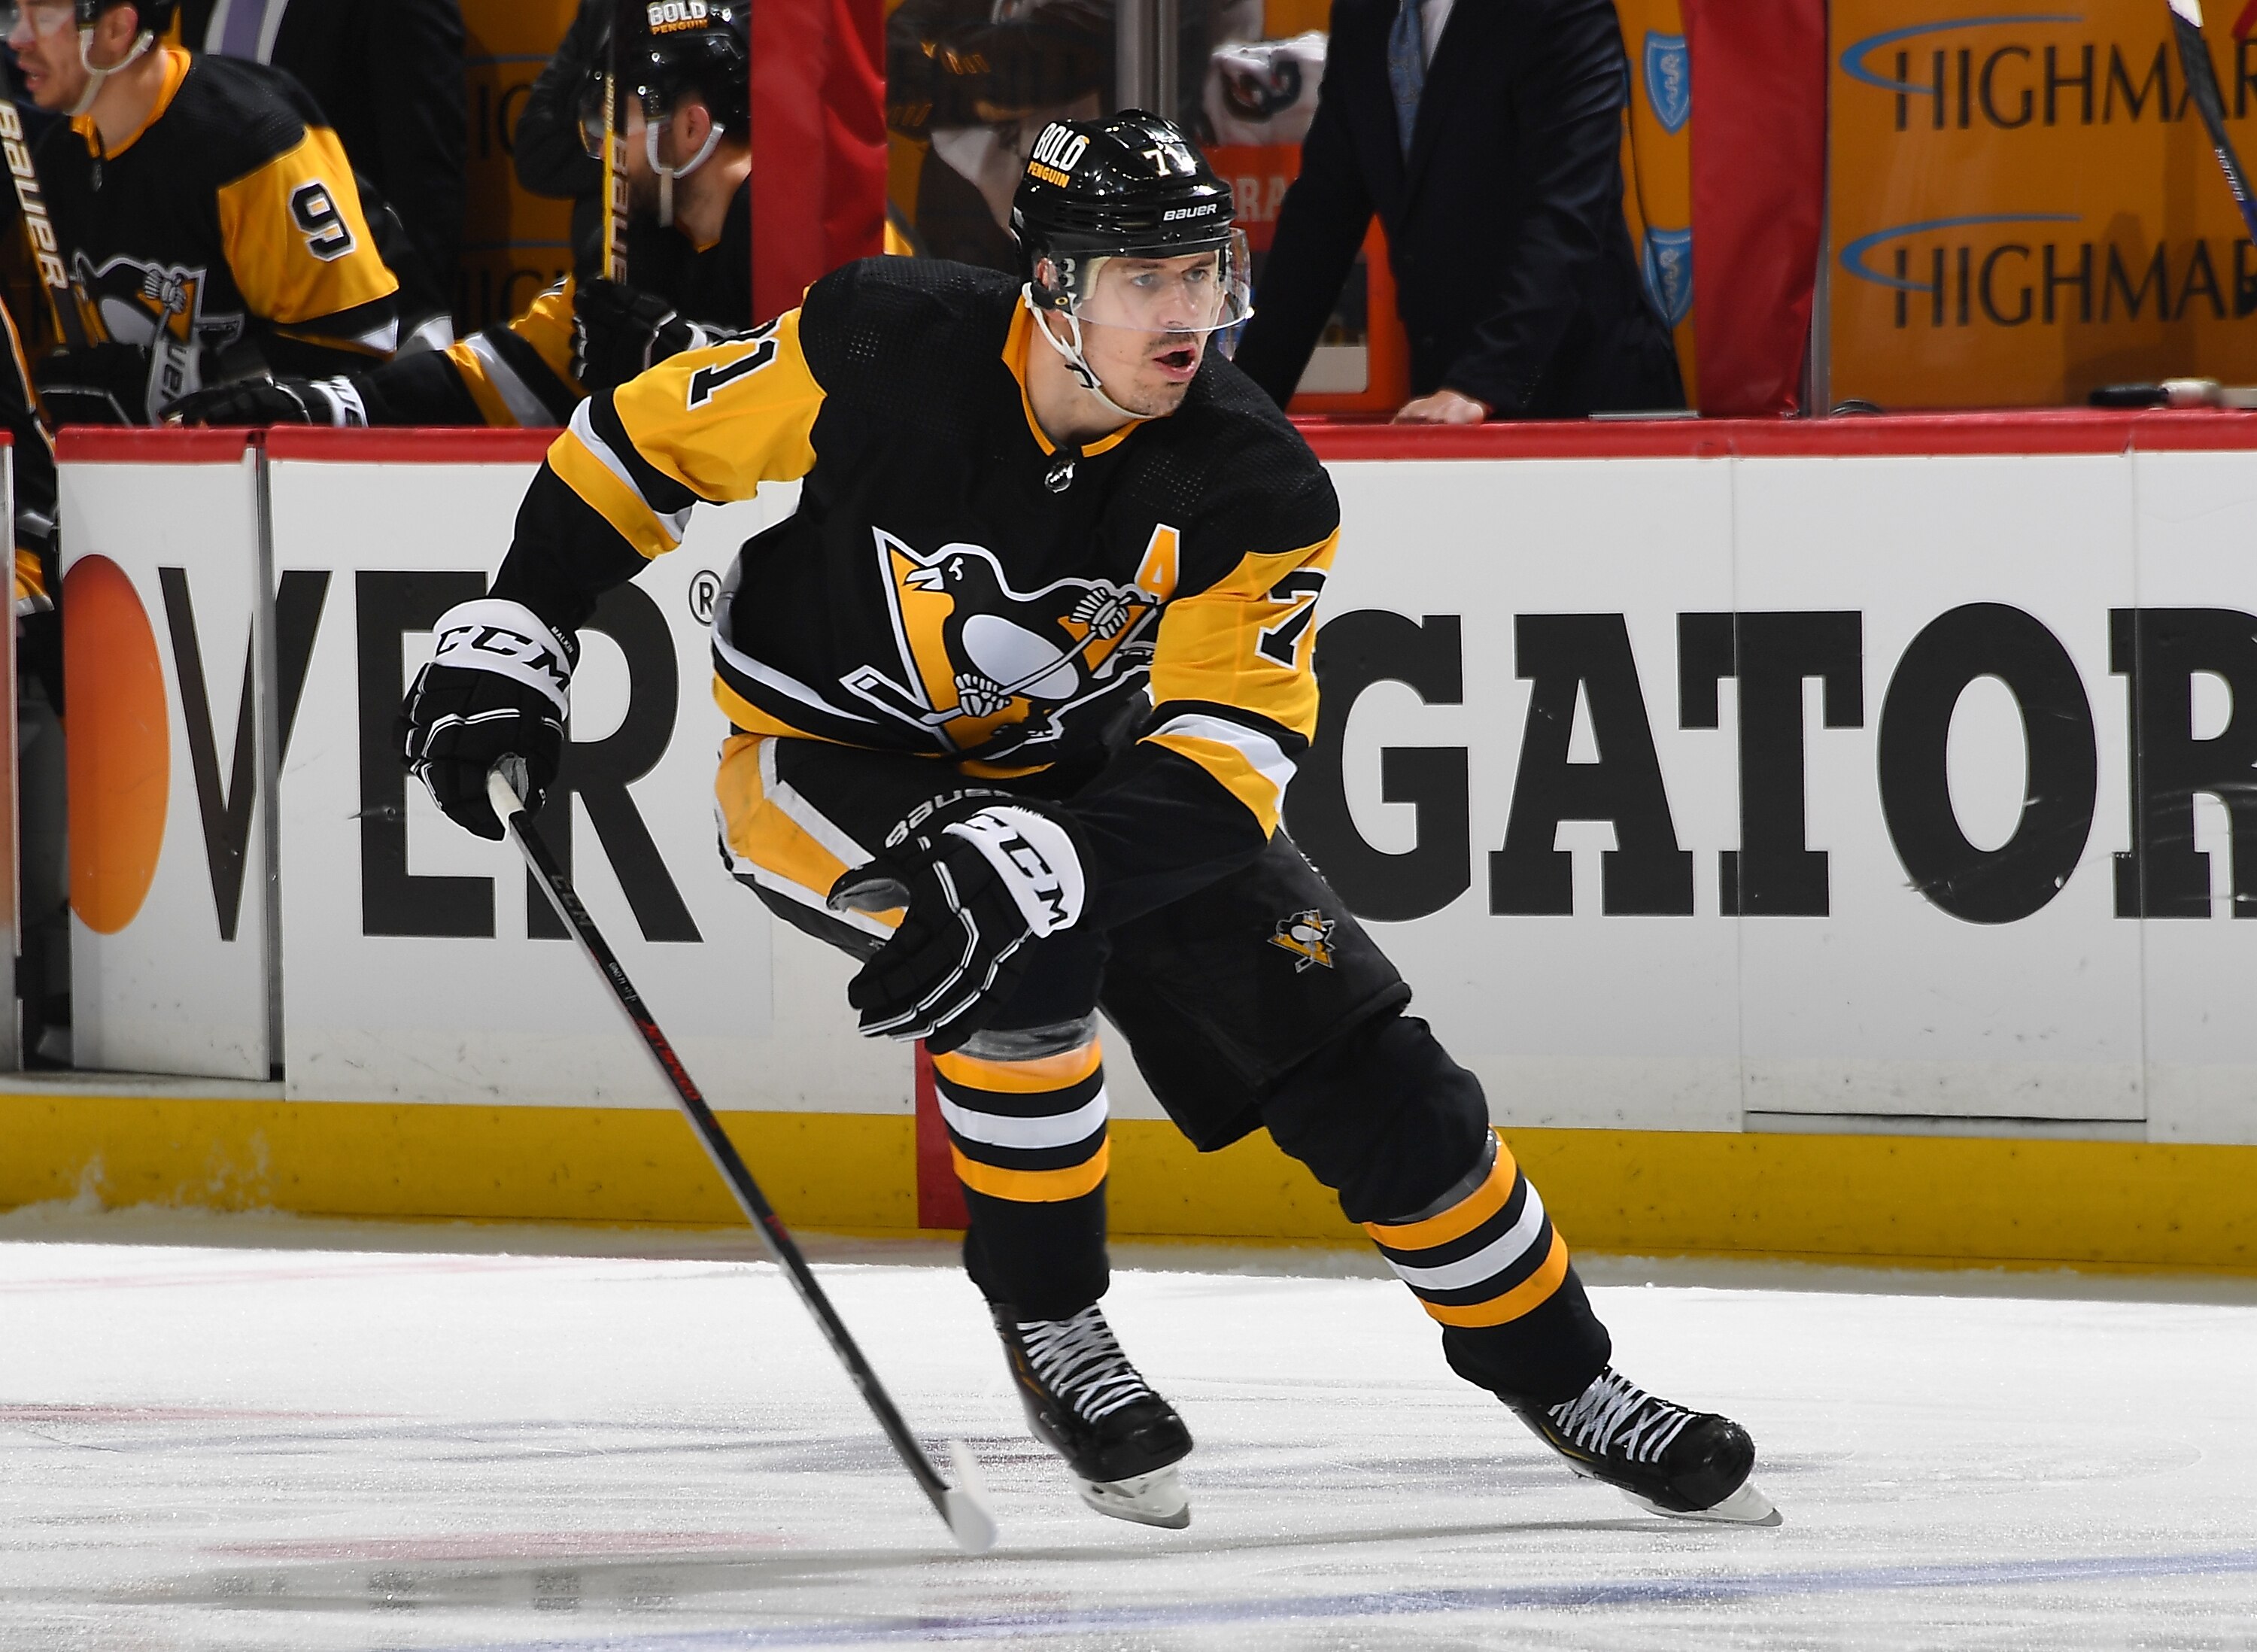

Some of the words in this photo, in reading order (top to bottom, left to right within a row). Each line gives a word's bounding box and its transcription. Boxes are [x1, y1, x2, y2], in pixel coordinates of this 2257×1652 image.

[647, 1, 708, 26] BOLD
[652, 19, 708, 35] PENGUIN
[1027, 161, 1071, 188] PENGUIN
[1033, 123, 1089, 172] BOLD
[0, 101, 69, 289] BAUER
[289, 180, 356, 263] 9
[611, 137, 628, 286] BAUE
[1162, 203, 1217, 222] BAUER
[687, 319, 780, 411] 1
[1134, 523, 1180, 605] A
[436, 625, 570, 693] CCM
[551, 626, 574, 654] MALKIN
[1282, 601, 2257, 927] GATOR
[964, 812, 1068, 927] CCM
